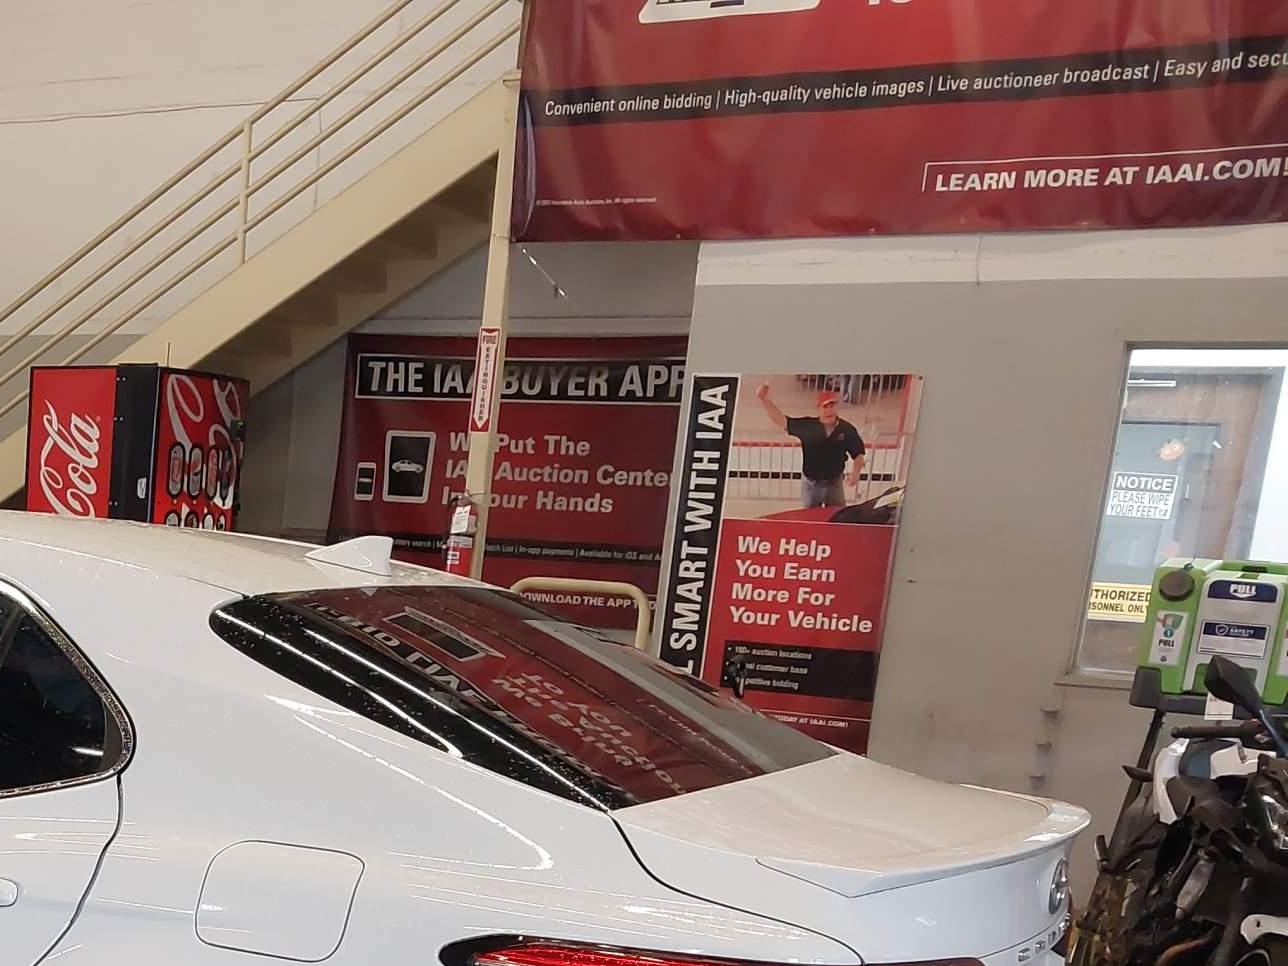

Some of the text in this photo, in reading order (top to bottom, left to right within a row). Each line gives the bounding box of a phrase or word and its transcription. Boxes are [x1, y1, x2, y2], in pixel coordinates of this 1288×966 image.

[545, 98, 615, 117] Convenient
[618, 96, 660, 112] online
[663, 92, 713, 111] bidding
[724, 85, 811, 107] High-quality
[814, 81, 868, 100] vehicle
[871, 78, 925, 98] images
[937, 74, 969, 92] Live
[973, 71, 1060, 91] auctioneer
[1063, 63, 1150, 84] broadcast
[1163, 59, 1207, 79] Easy
[1211, 52, 1244, 74] and
[935, 171, 1017, 192] LEARN
[1023, 168, 1100, 189] MORE
[1104, 165, 1140, 186] AT
[368, 361, 425, 393] THE
[501, 364, 610, 397] BUYER
[495, 433, 535, 454] Put
[543, 434, 592, 456] The
[494, 461, 589, 484] Auction
[1115, 475, 1174, 491] NOTICE
[490, 493, 529, 509] our
[535, 490, 614, 513] Hands
[1112, 490, 1171, 506] PLEASE WIPE
[669, 384, 730, 651] SMART WITH IAA
[1110, 503, 1159, 517] YOUR FEET
[737, 535, 832, 561] We Help
[735, 559, 836, 582] You Earn
[731, 583, 836, 606] More For
[1229, 583, 1257, 595] PULL
[582, 595, 605, 607] THE
[606, 598, 631, 609] APP
[729, 605, 873, 633] Your Vehicle
[1158, 638, 1175, 647] PULL
